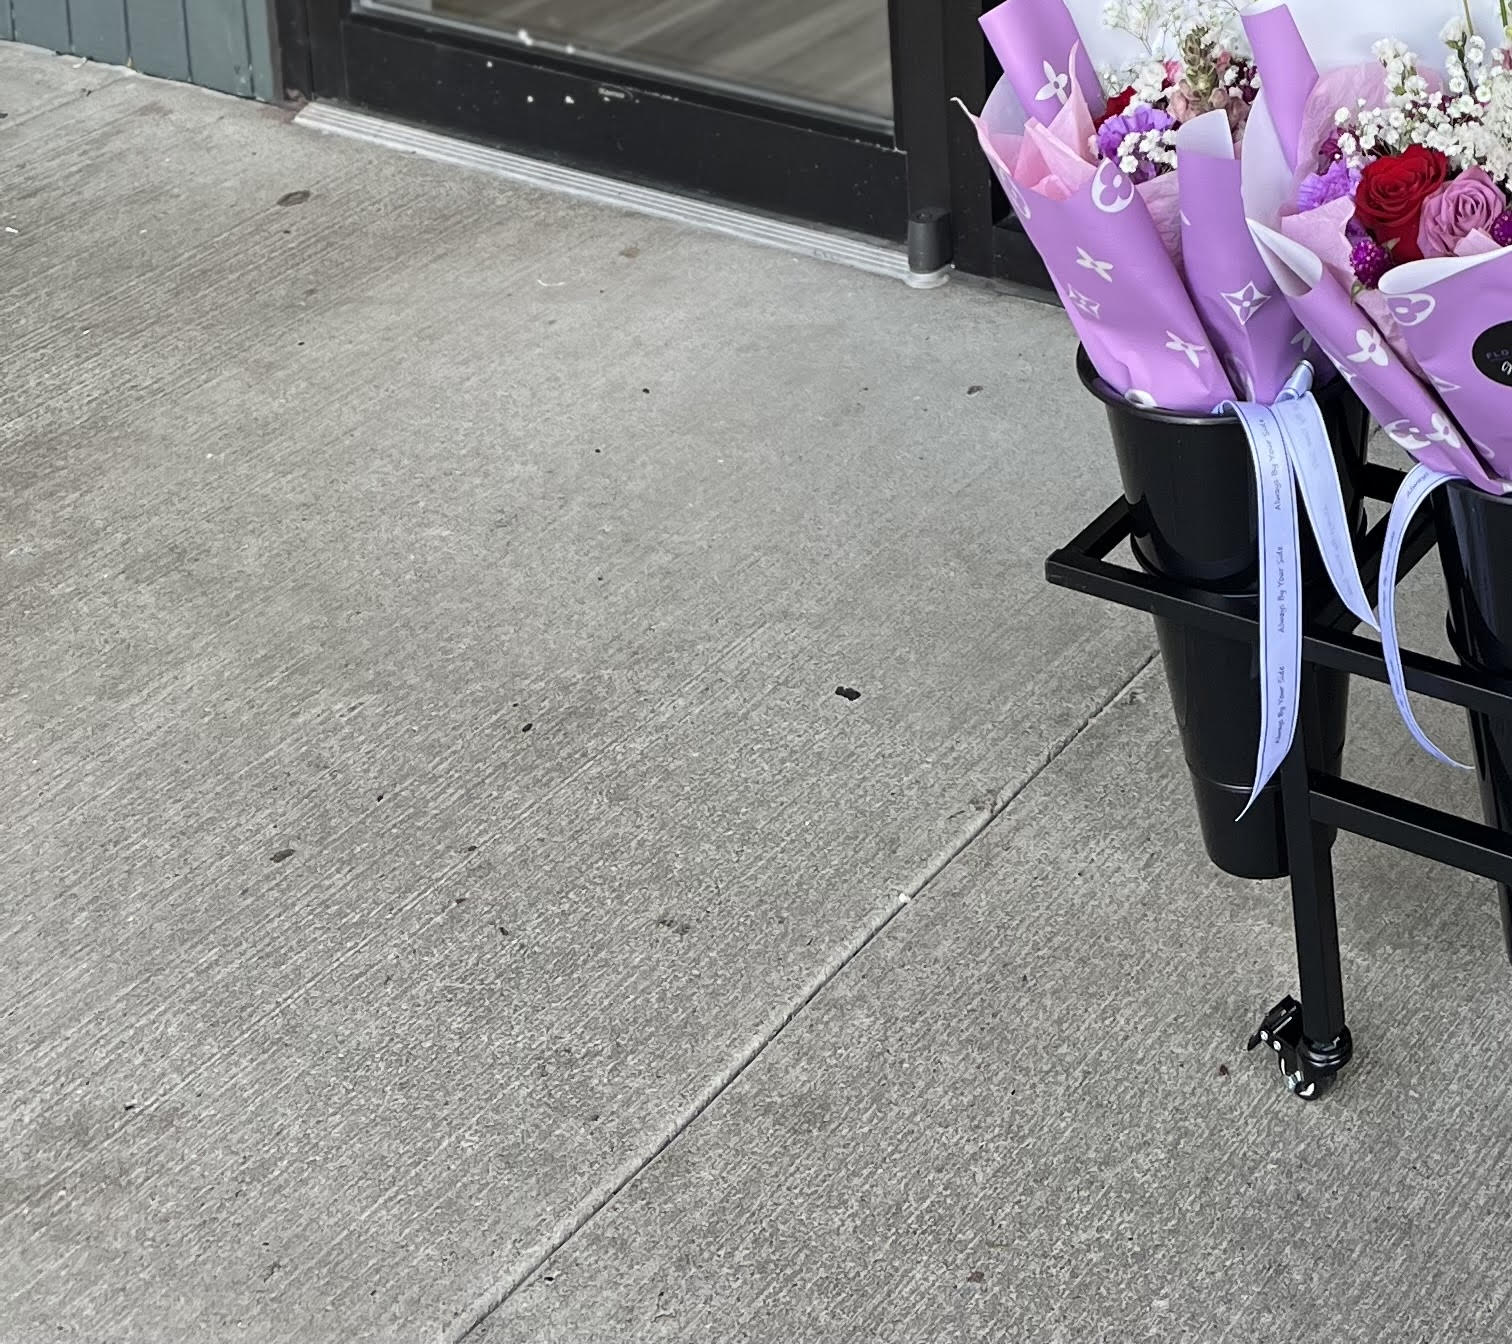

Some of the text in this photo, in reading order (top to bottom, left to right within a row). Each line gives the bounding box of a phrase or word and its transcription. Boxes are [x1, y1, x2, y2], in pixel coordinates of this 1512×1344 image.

[1277, 568, 1285, 587] Your
[1277, 590, 1287, 601] By
[1277, 604, 1287, 633] Always
